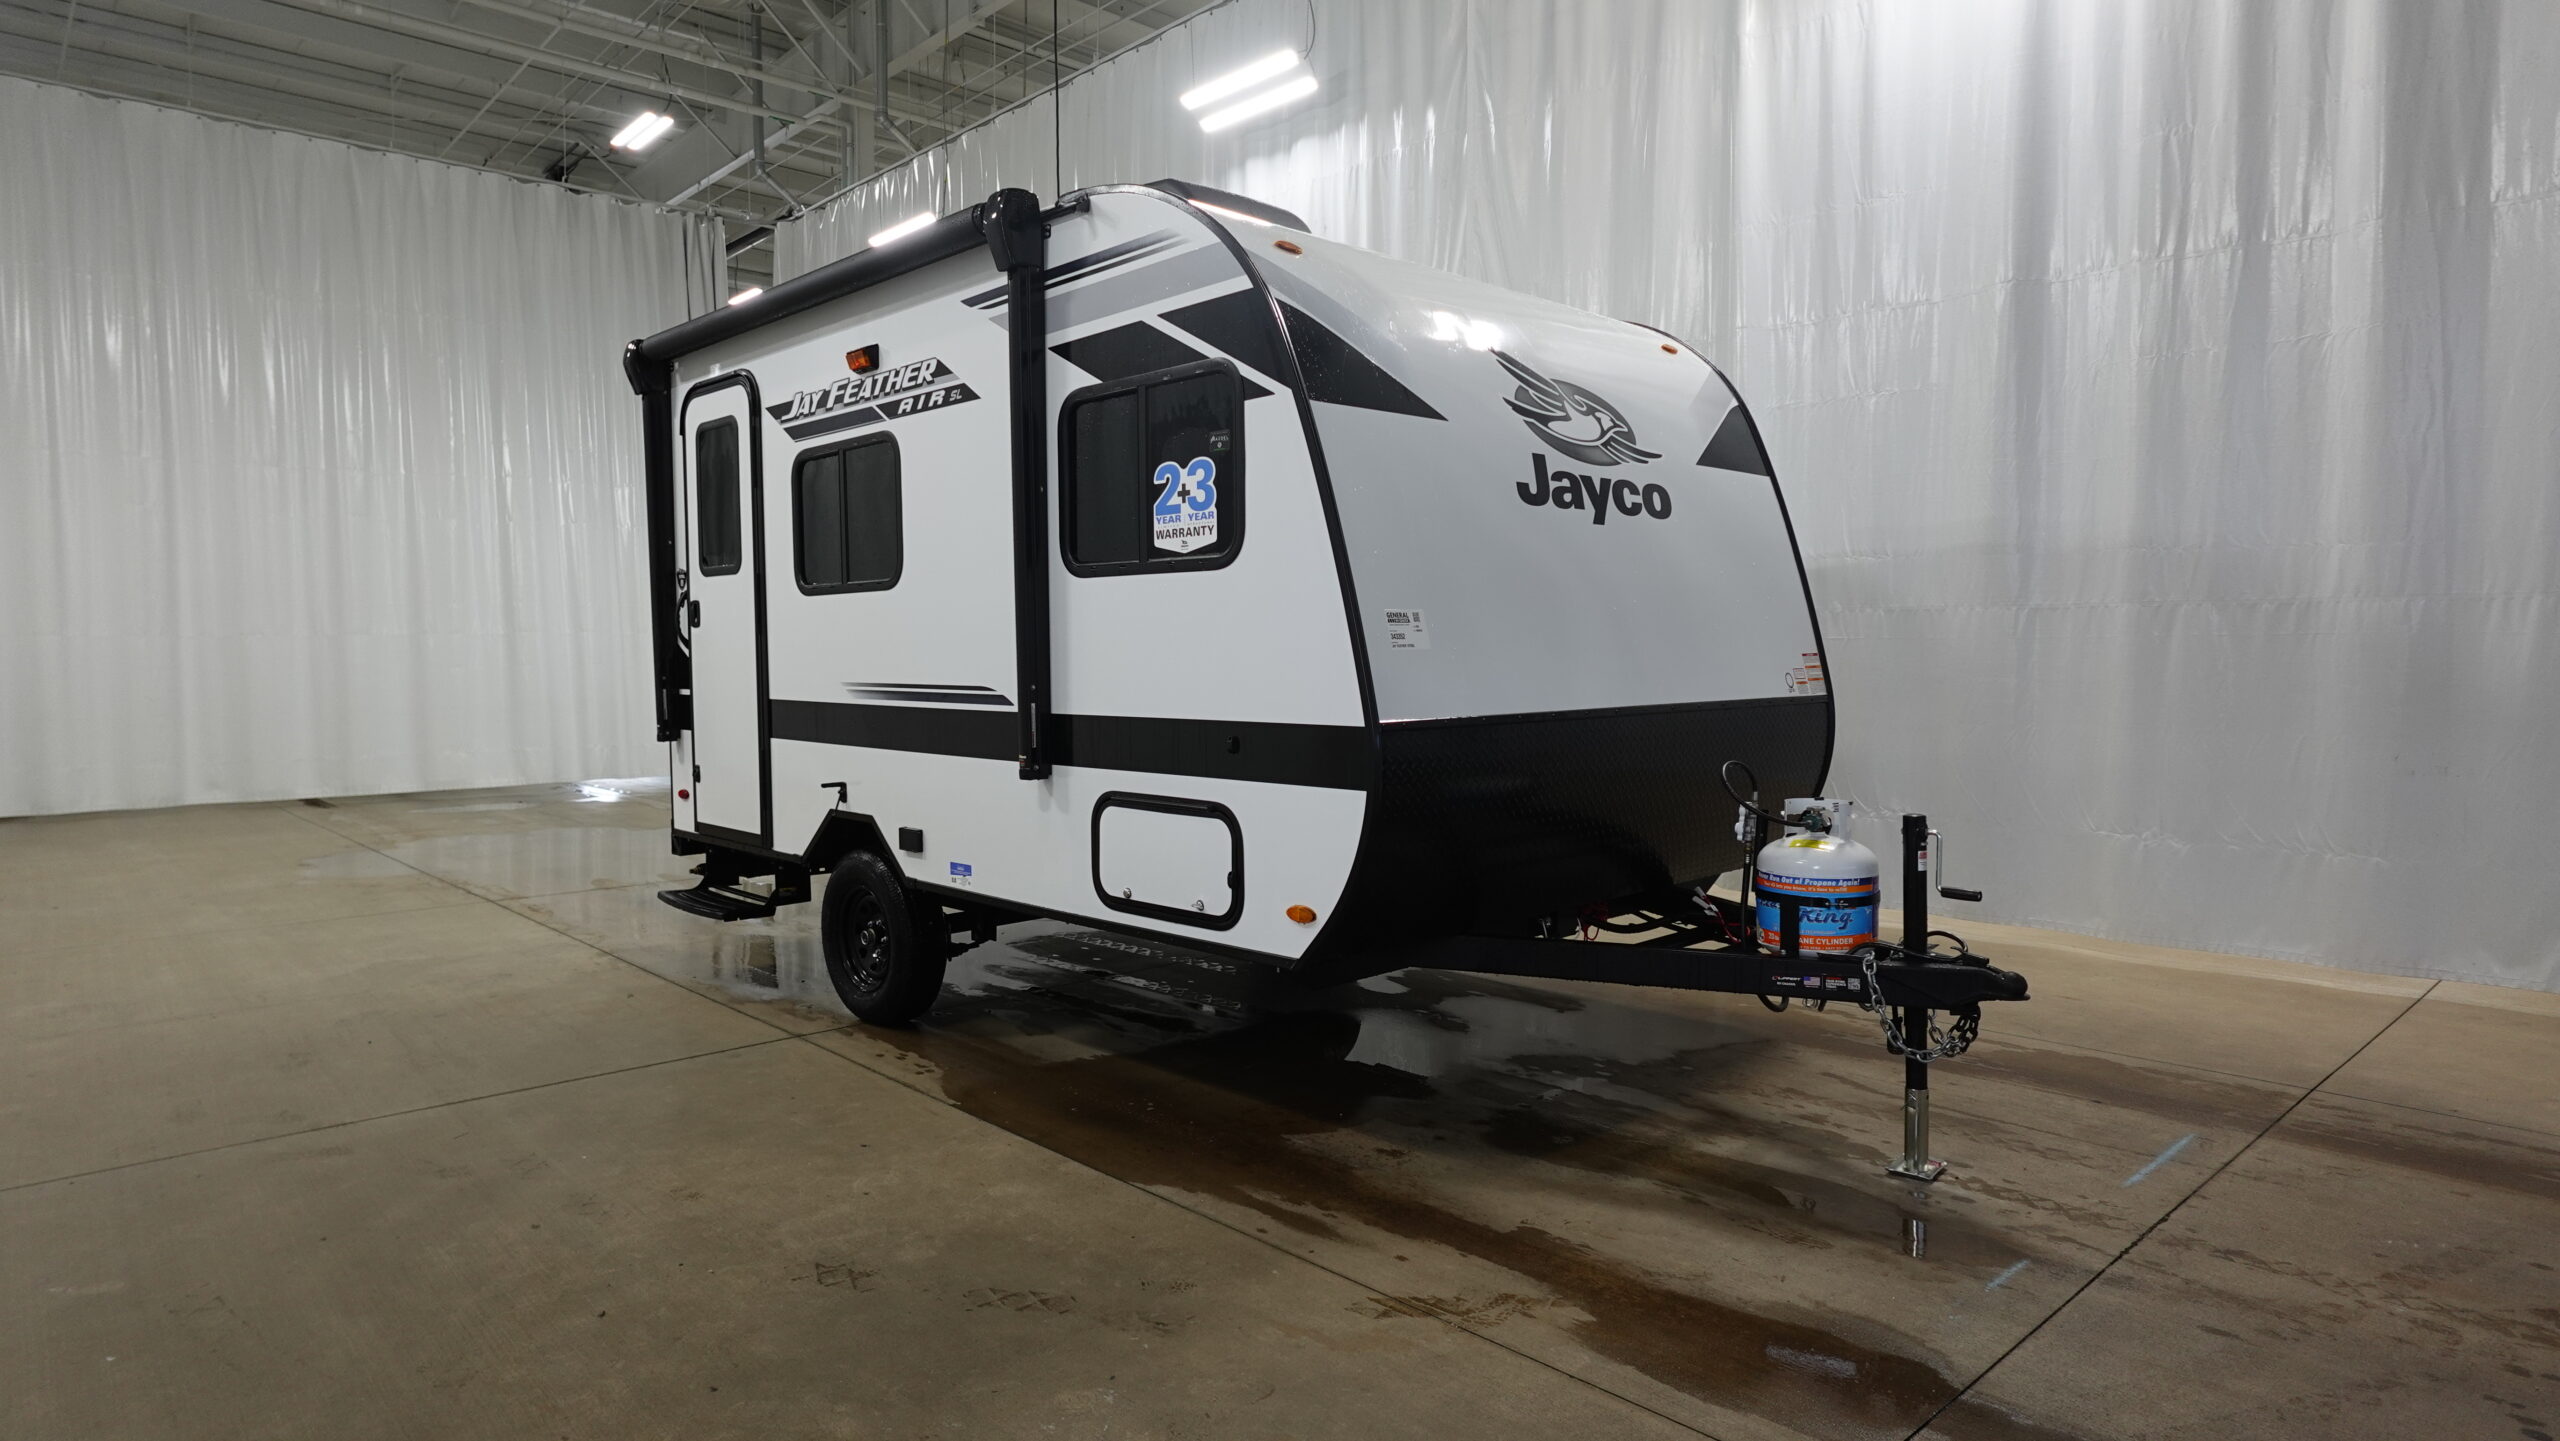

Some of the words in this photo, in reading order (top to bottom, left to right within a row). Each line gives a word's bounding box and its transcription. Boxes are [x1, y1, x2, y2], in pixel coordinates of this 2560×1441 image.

[780, 391, 823, 422] JAY
[825, 357, 938, 411] FEATHER
[898, 389, 946, 415] AIR
[1516, 453, 1672, 525] Jayco
[1156, 515, 1181, 525] YEAR
[1188, 511, 1214, 521] YEAR
[1156, 525, 1214, 540] WARRANTY
[1804, 879, 1836, 887] Propane
[1838, 878, 1860, 887] Again!
